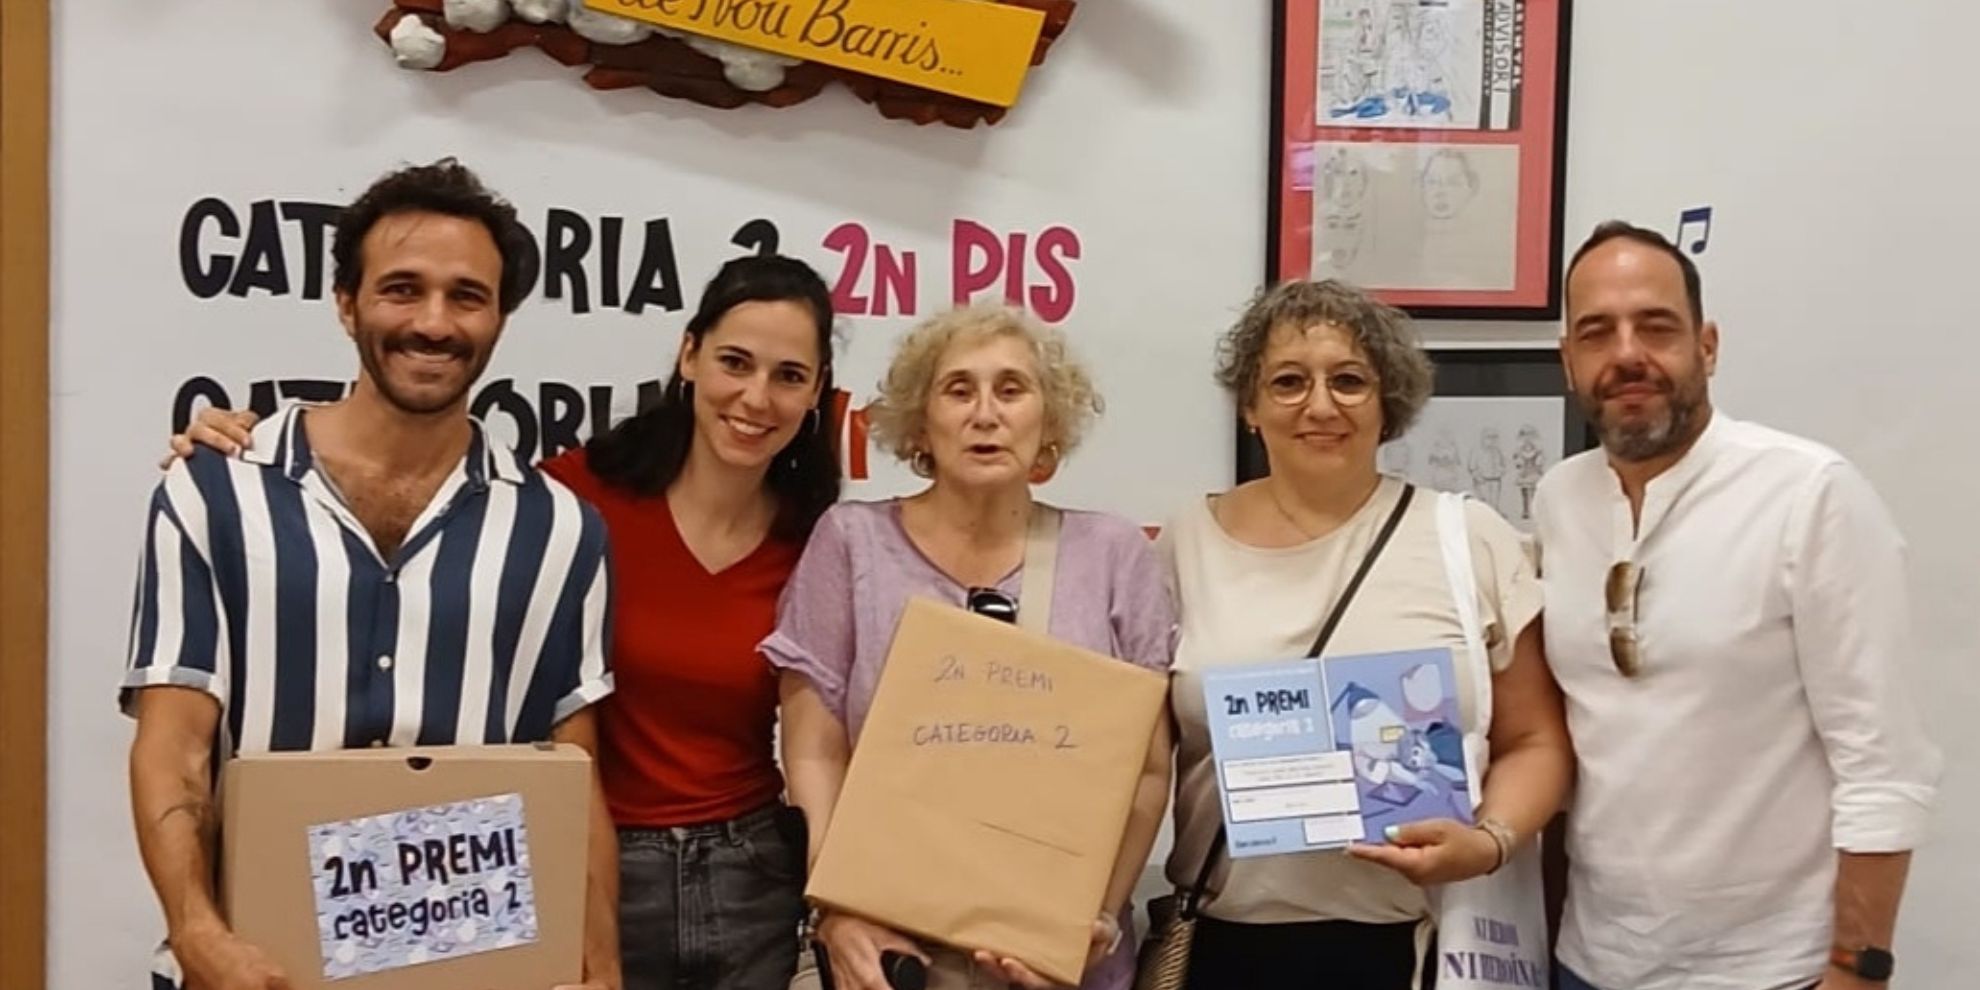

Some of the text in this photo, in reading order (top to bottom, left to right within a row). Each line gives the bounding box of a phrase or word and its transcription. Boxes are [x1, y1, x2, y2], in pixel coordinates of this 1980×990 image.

[179, 197, 1082, 324] CATORIA 2N PIS
[986, 661, 1053, 692] PREMI
[1255, 688, 1311, 716] PREMI
[912, 722, 1079, 750] CATEGORIA 2
[323, 828, 518, 898] 2n PREMI
[333, 881, 522, 941] categoria 2
